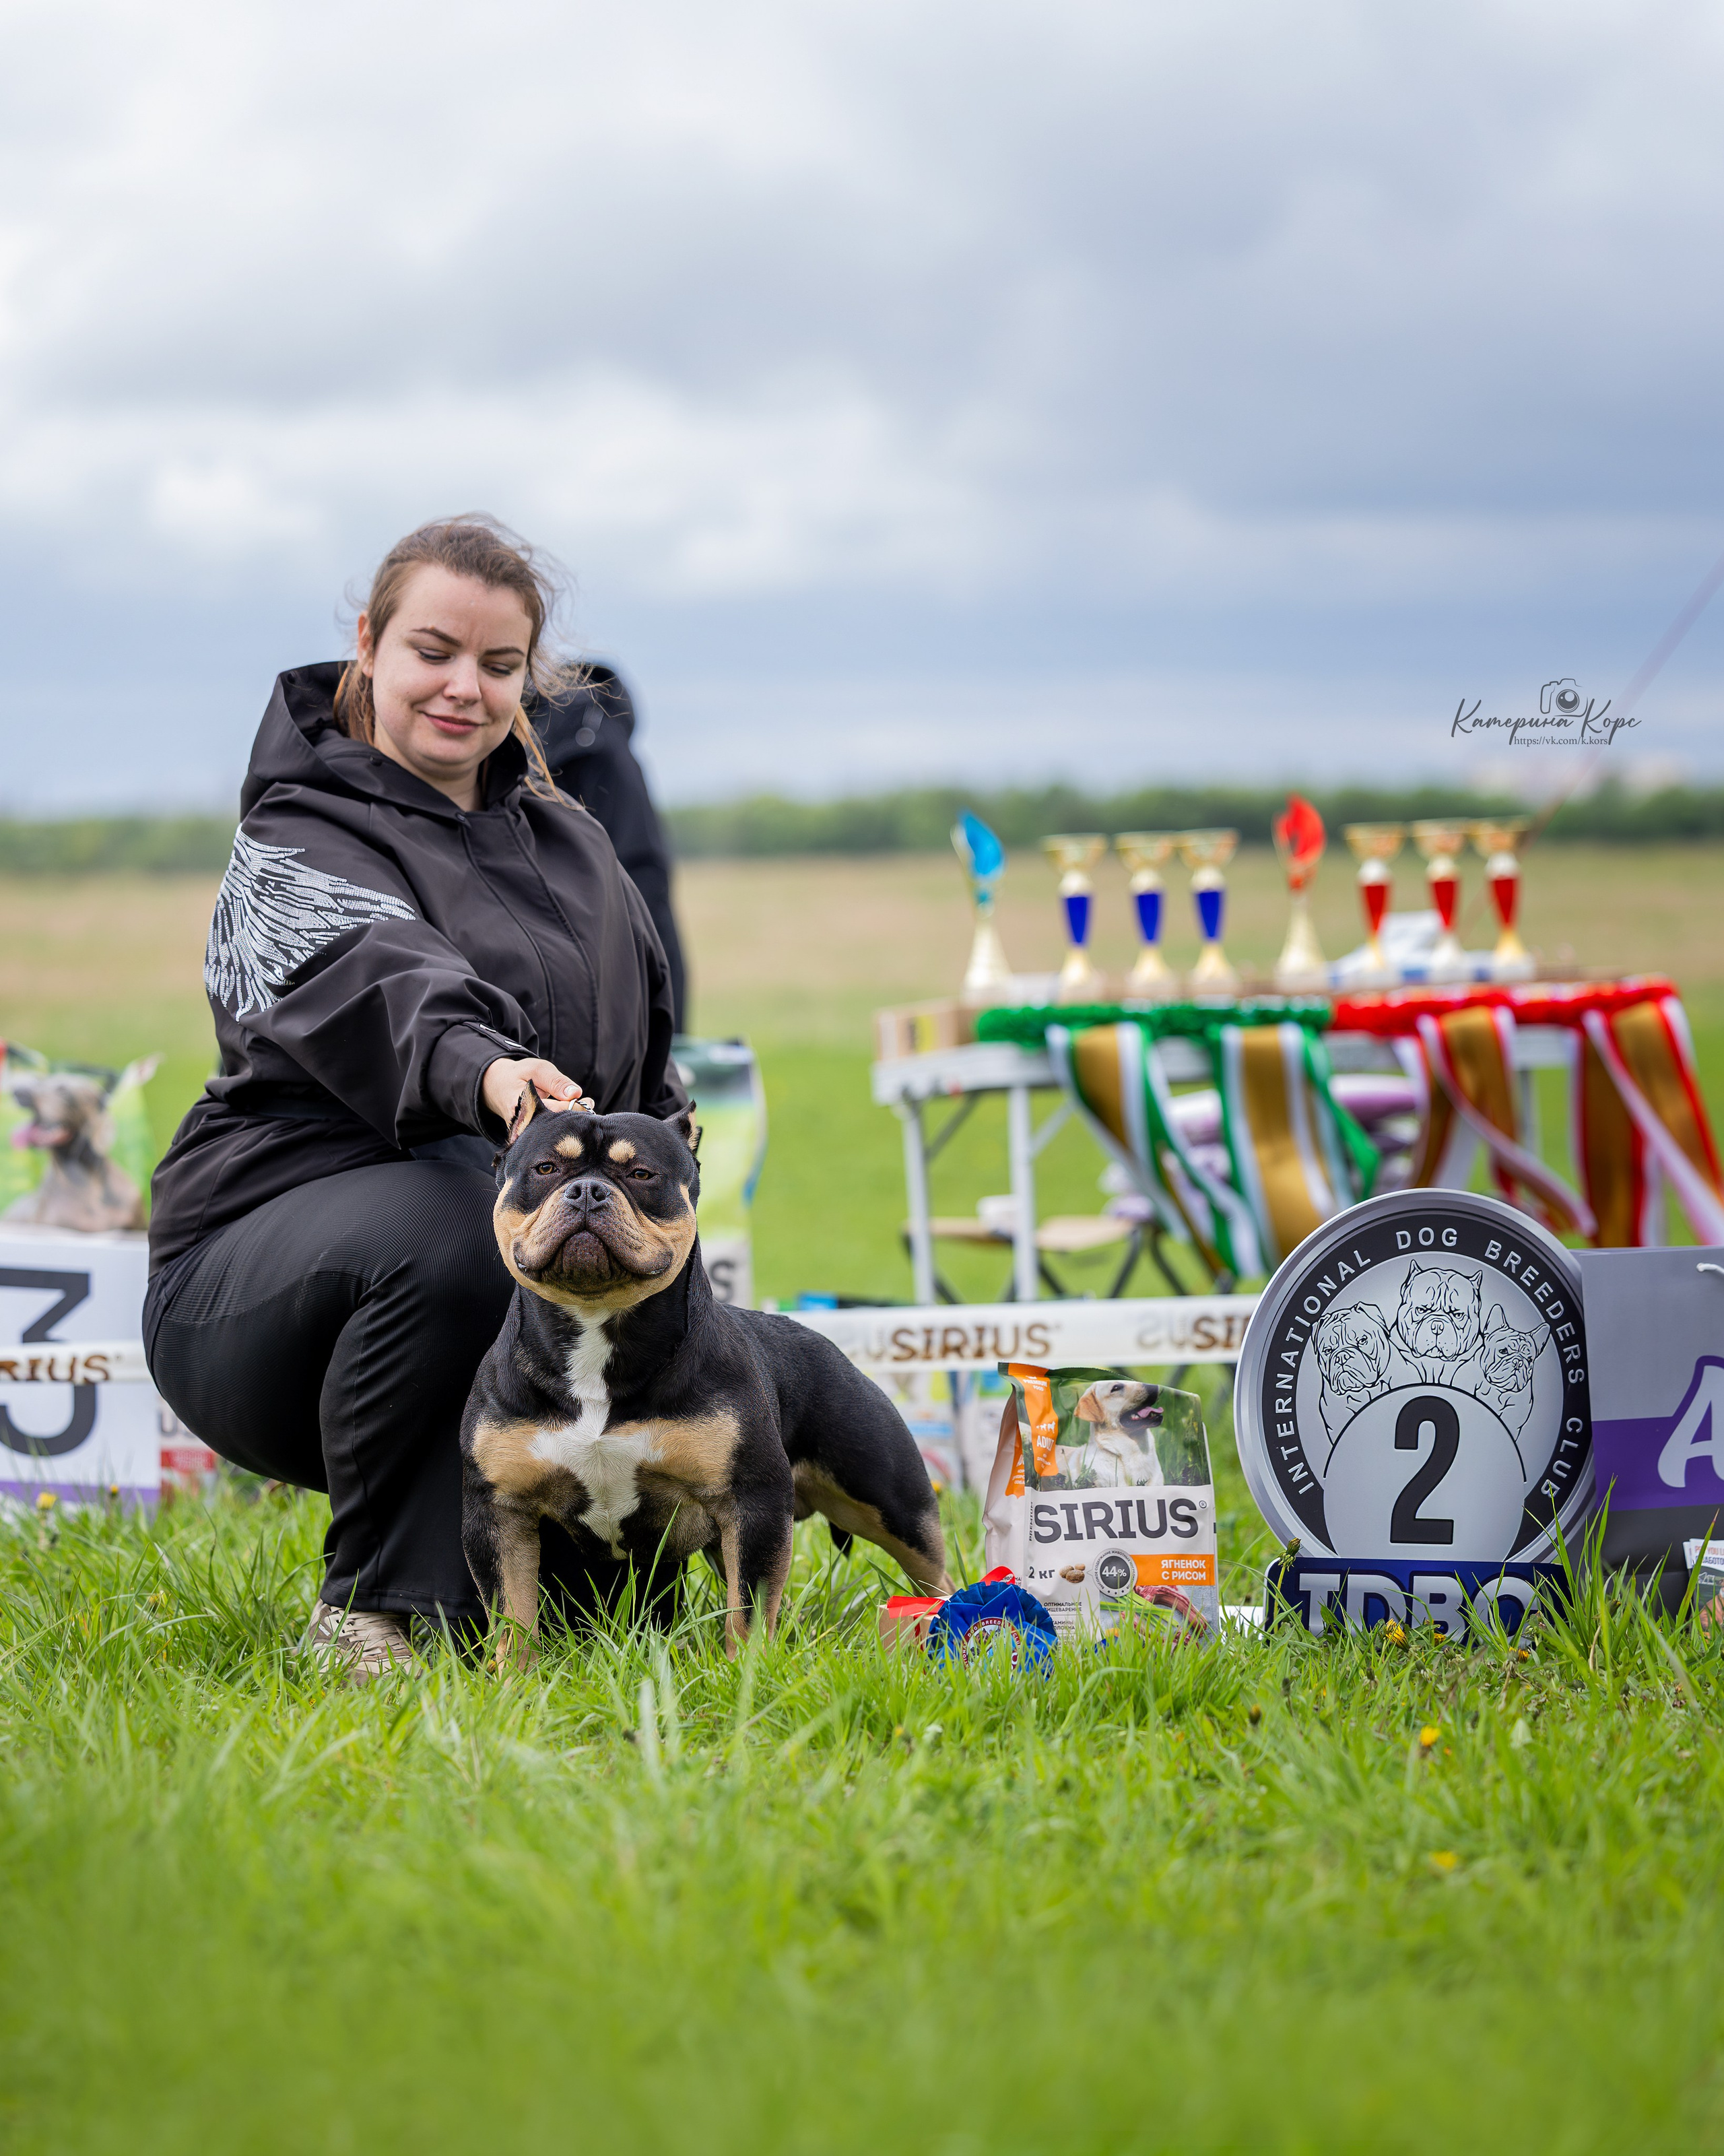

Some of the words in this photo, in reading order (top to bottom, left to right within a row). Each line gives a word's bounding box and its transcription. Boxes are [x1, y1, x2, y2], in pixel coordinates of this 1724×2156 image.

[891, 1323, 1053, 1363] SIRIUS
[1275, 1249, 1371, 1495] INTERNATIONAL
[1396, 1227, 1458, 1250] DOG
[1484, 1239, 1585, 1385] BREEDERS
[1539, 1416, 1584, 1499] CLUB
[1036, 1435, 1055, 1451] ADULT
[1389, 1396, 1460, 1544] 2
[1102, 1565, 1127, 1577] 44%
[1161, 1559, 1206, 1569] ЯГНЕНОК
[1028, 1566, 1035, 1579] 2
[1161, 1571, 1170, 1580] С
[1172, 1571, 1206, 1580] РИСОМ
